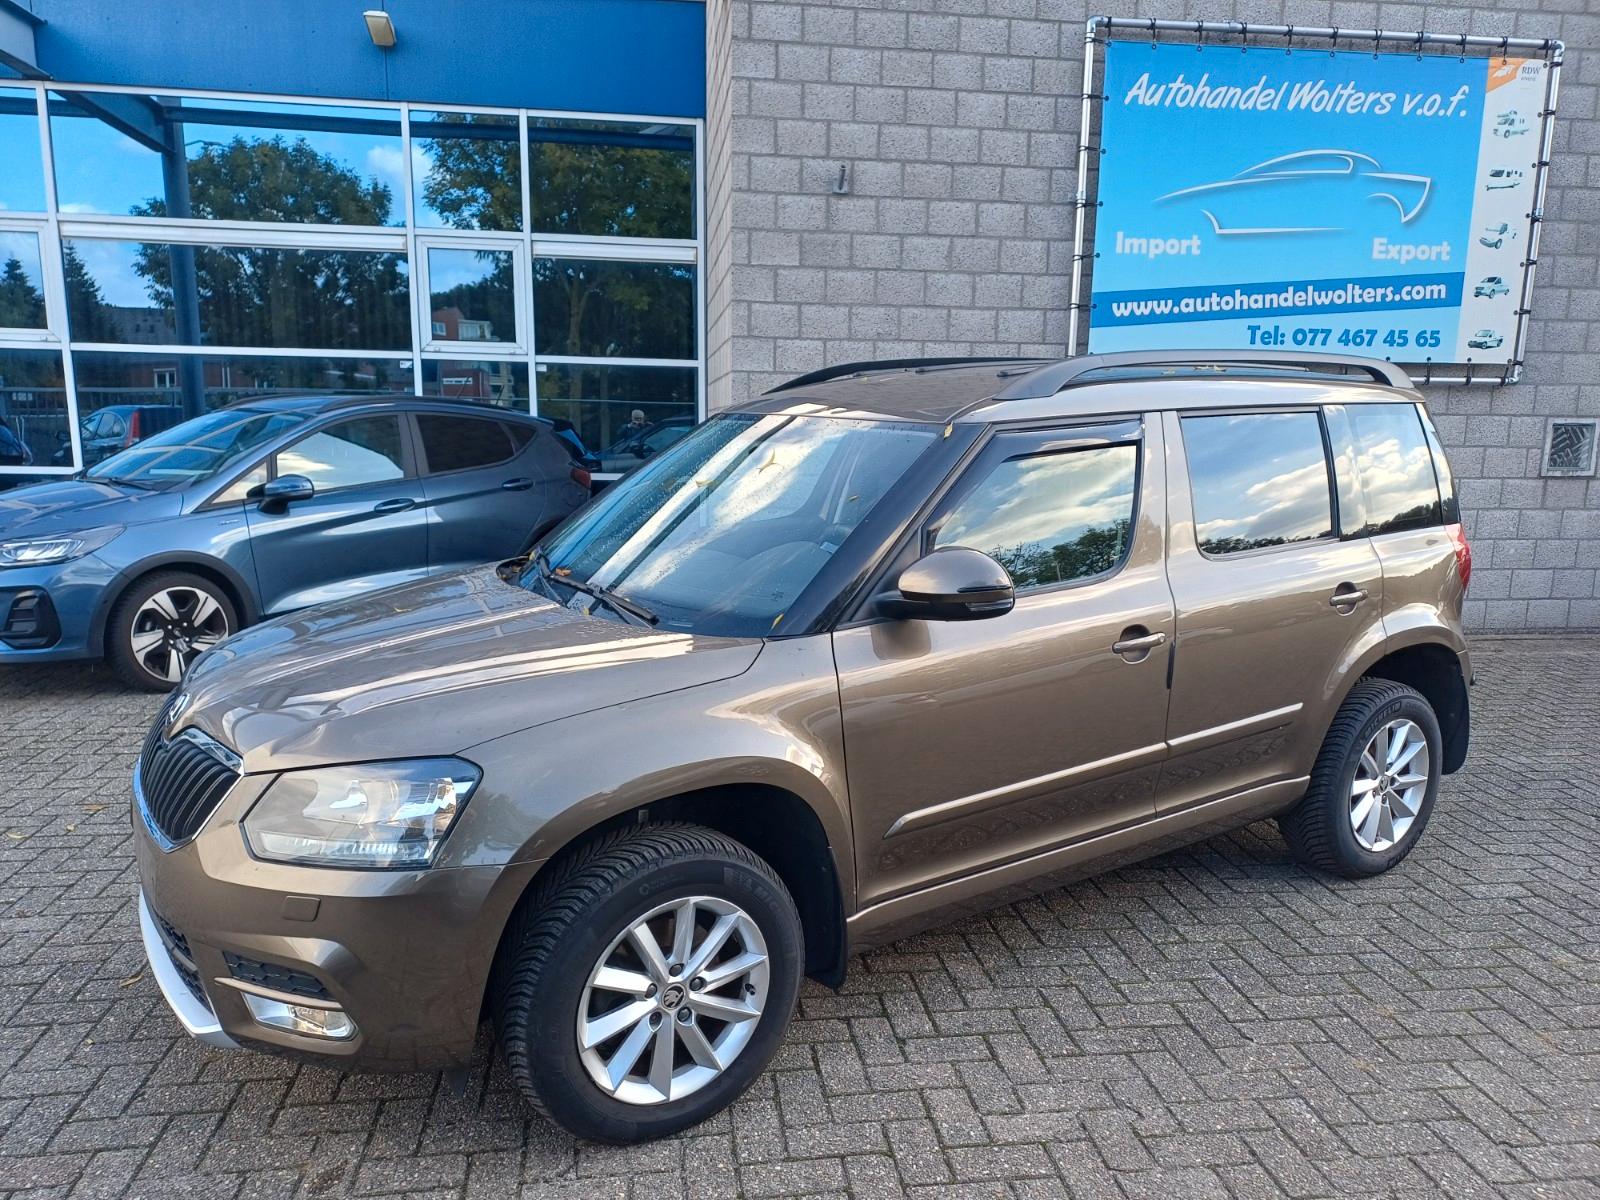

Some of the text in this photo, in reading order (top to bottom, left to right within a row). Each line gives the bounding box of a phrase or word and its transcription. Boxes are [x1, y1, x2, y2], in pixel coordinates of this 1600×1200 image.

[1124, 72, 1470, 118] Autohandel Wolters v.o.f.
[1115, 231, 1202, 259] Import
[1371, 237, 1451, 264] Export
[1111, 283, 1447, 317] www.autohandelwolters.com
[1247, 325, 1441, 348] Tel: 077 467 45 65
